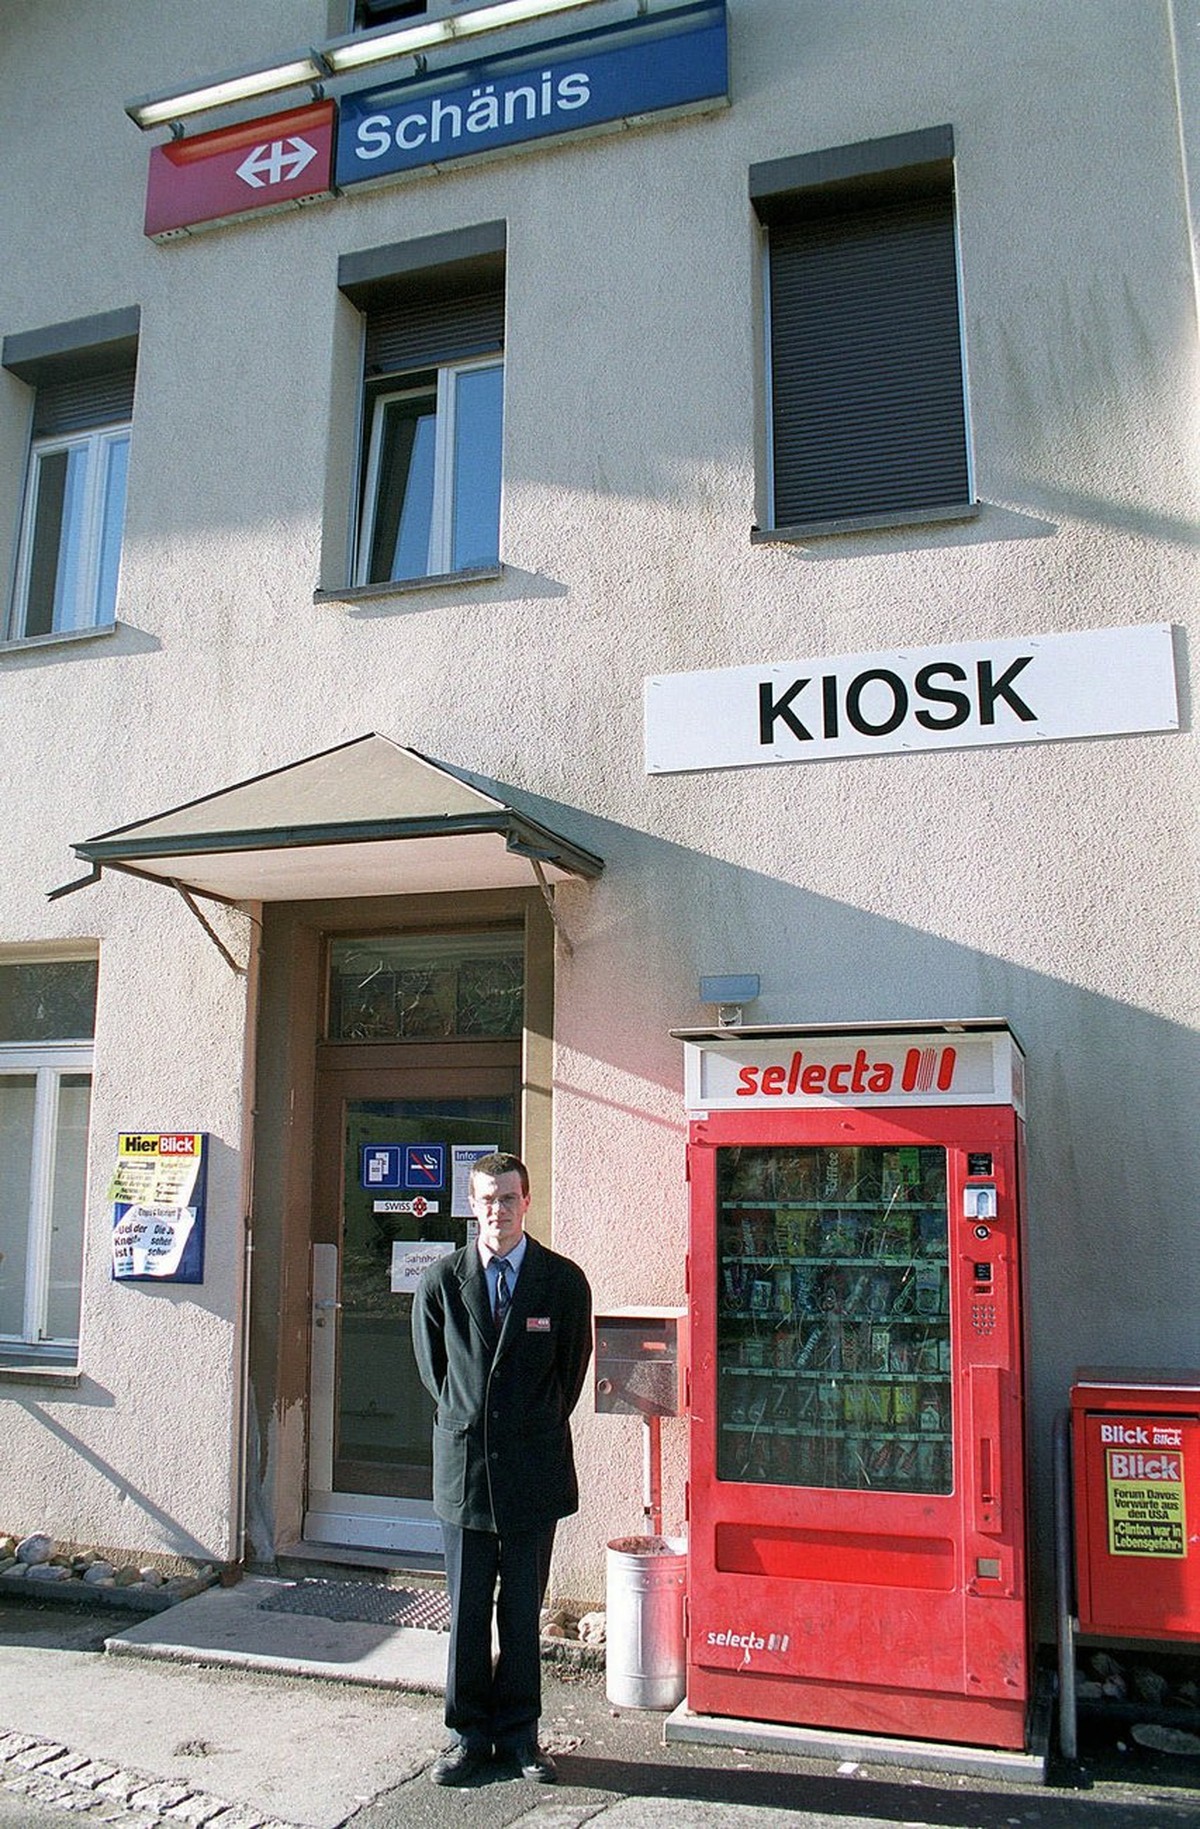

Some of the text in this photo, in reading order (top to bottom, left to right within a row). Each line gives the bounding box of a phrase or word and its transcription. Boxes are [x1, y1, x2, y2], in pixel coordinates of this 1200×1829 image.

[355, 71, 592, 161] Schänis
[758, 656, 1038, 745] KIOSK
[736, 1049, 894, 1096] selecta
[125, 1135, 194, 1153] Hier Blick
[384, 1202, 411, 1211] SWISS
[1101, 1425, 1150, 1445] Blick
[1153, 1434, 1182, 1446] Blick
[1112, 1454, 1180, 1480] Blick
[1114, 1488, 1180, 1501] Forum Davos:
[1128, 1509, 1170, 1520] den USA
[1161, 1502, 1179, 1510] aus
[1153, 1526, 1171, 1537] war
[1172, 1524, 1182, 1538] in
[707, 1628, 765, 1651] selecta
